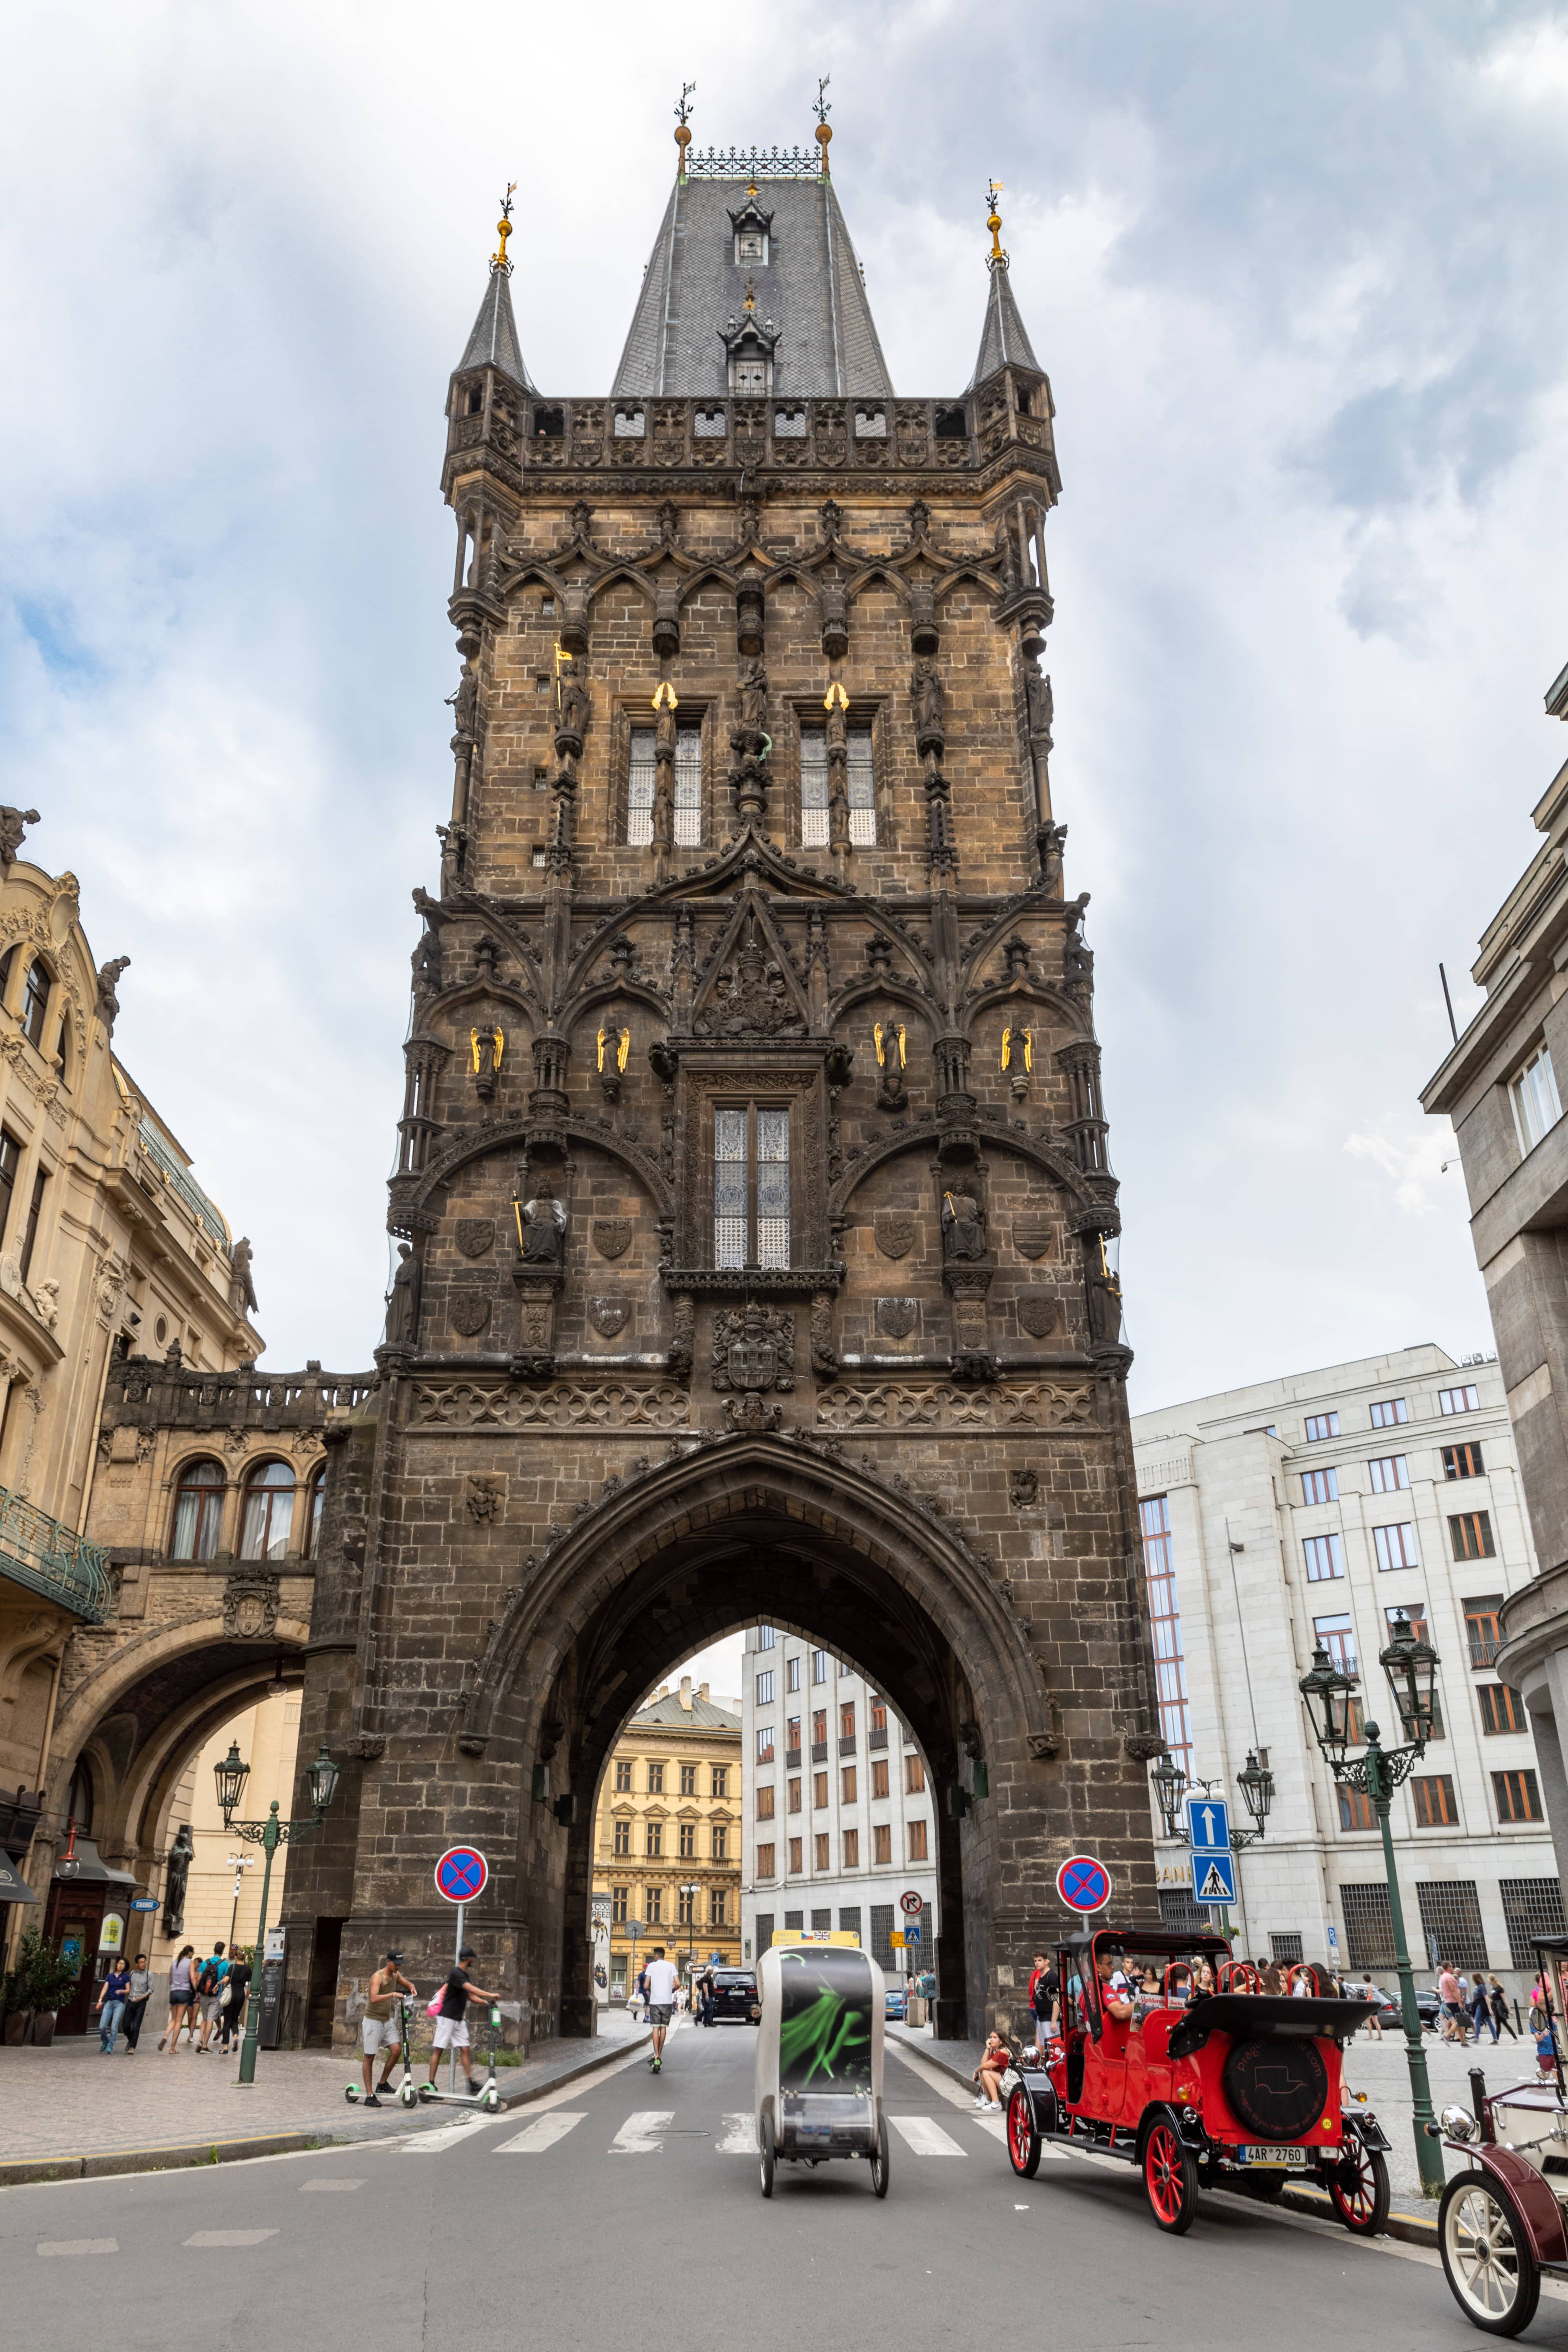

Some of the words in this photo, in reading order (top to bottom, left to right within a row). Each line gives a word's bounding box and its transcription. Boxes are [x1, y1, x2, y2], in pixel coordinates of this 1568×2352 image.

[1329, 1929, 1334, 1940] P
[1248, 2147, 1267, 2160] 4AR
[1276, 2149, 1301, 2161] 2760
